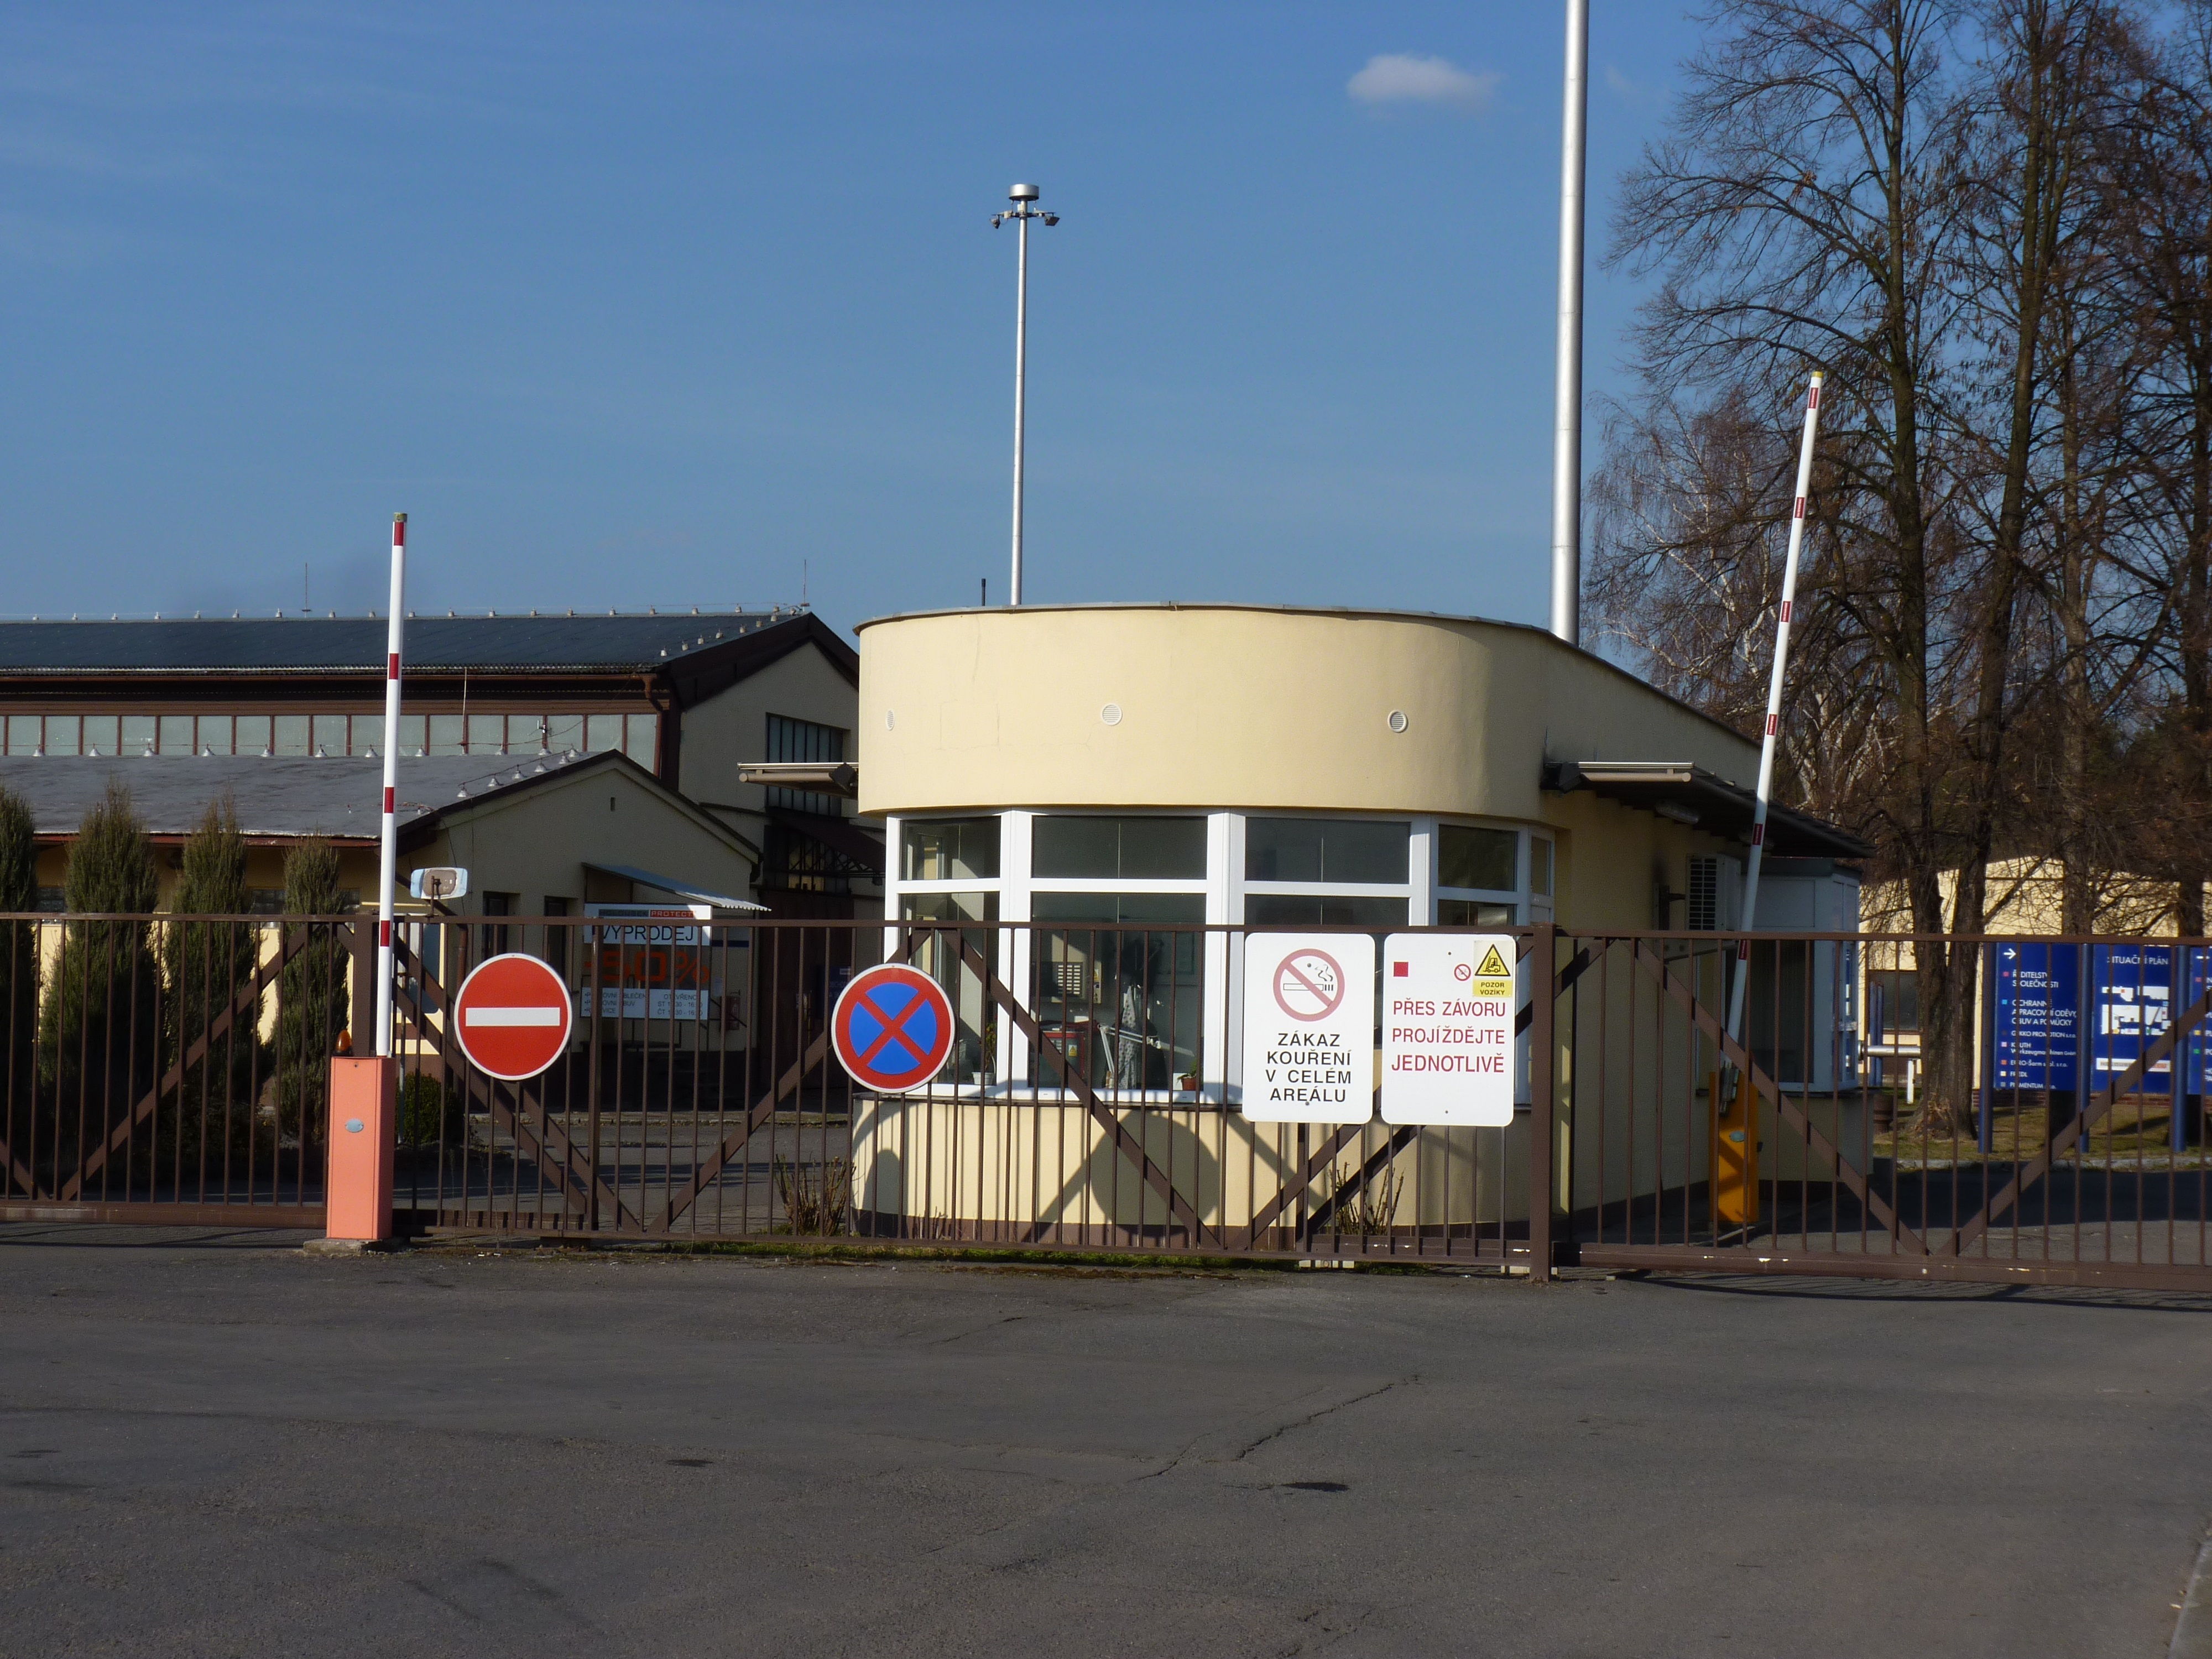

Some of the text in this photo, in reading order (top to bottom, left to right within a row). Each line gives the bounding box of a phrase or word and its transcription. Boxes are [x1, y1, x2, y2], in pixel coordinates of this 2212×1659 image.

[2106, 954, 2147, 964] ITUAČÍ
[2012, 969, 2049, 978] ŘDITELST
[2012, 979, 2059, 988] SOLEČNOSTI
[1393, 998, 1506, 1017] PŘES ZÁVORU
[2018, 1008, 2055, 1016] PRACOVÍ
[1277, 1030, 1340, 1047] ZÁKAZ
[1392, 1025, 1505, 1045] PROJÍŽDĚJTE
[1267, 1049, 1352, 1066] KOUŘENÍ
[1391, 1052, 1505, 1073] JEDNOTLIVĚ
[1265, 1067, 1352, 1084] V CELÉM
[1270, 1086, 1346, 1103] AREÁLU
